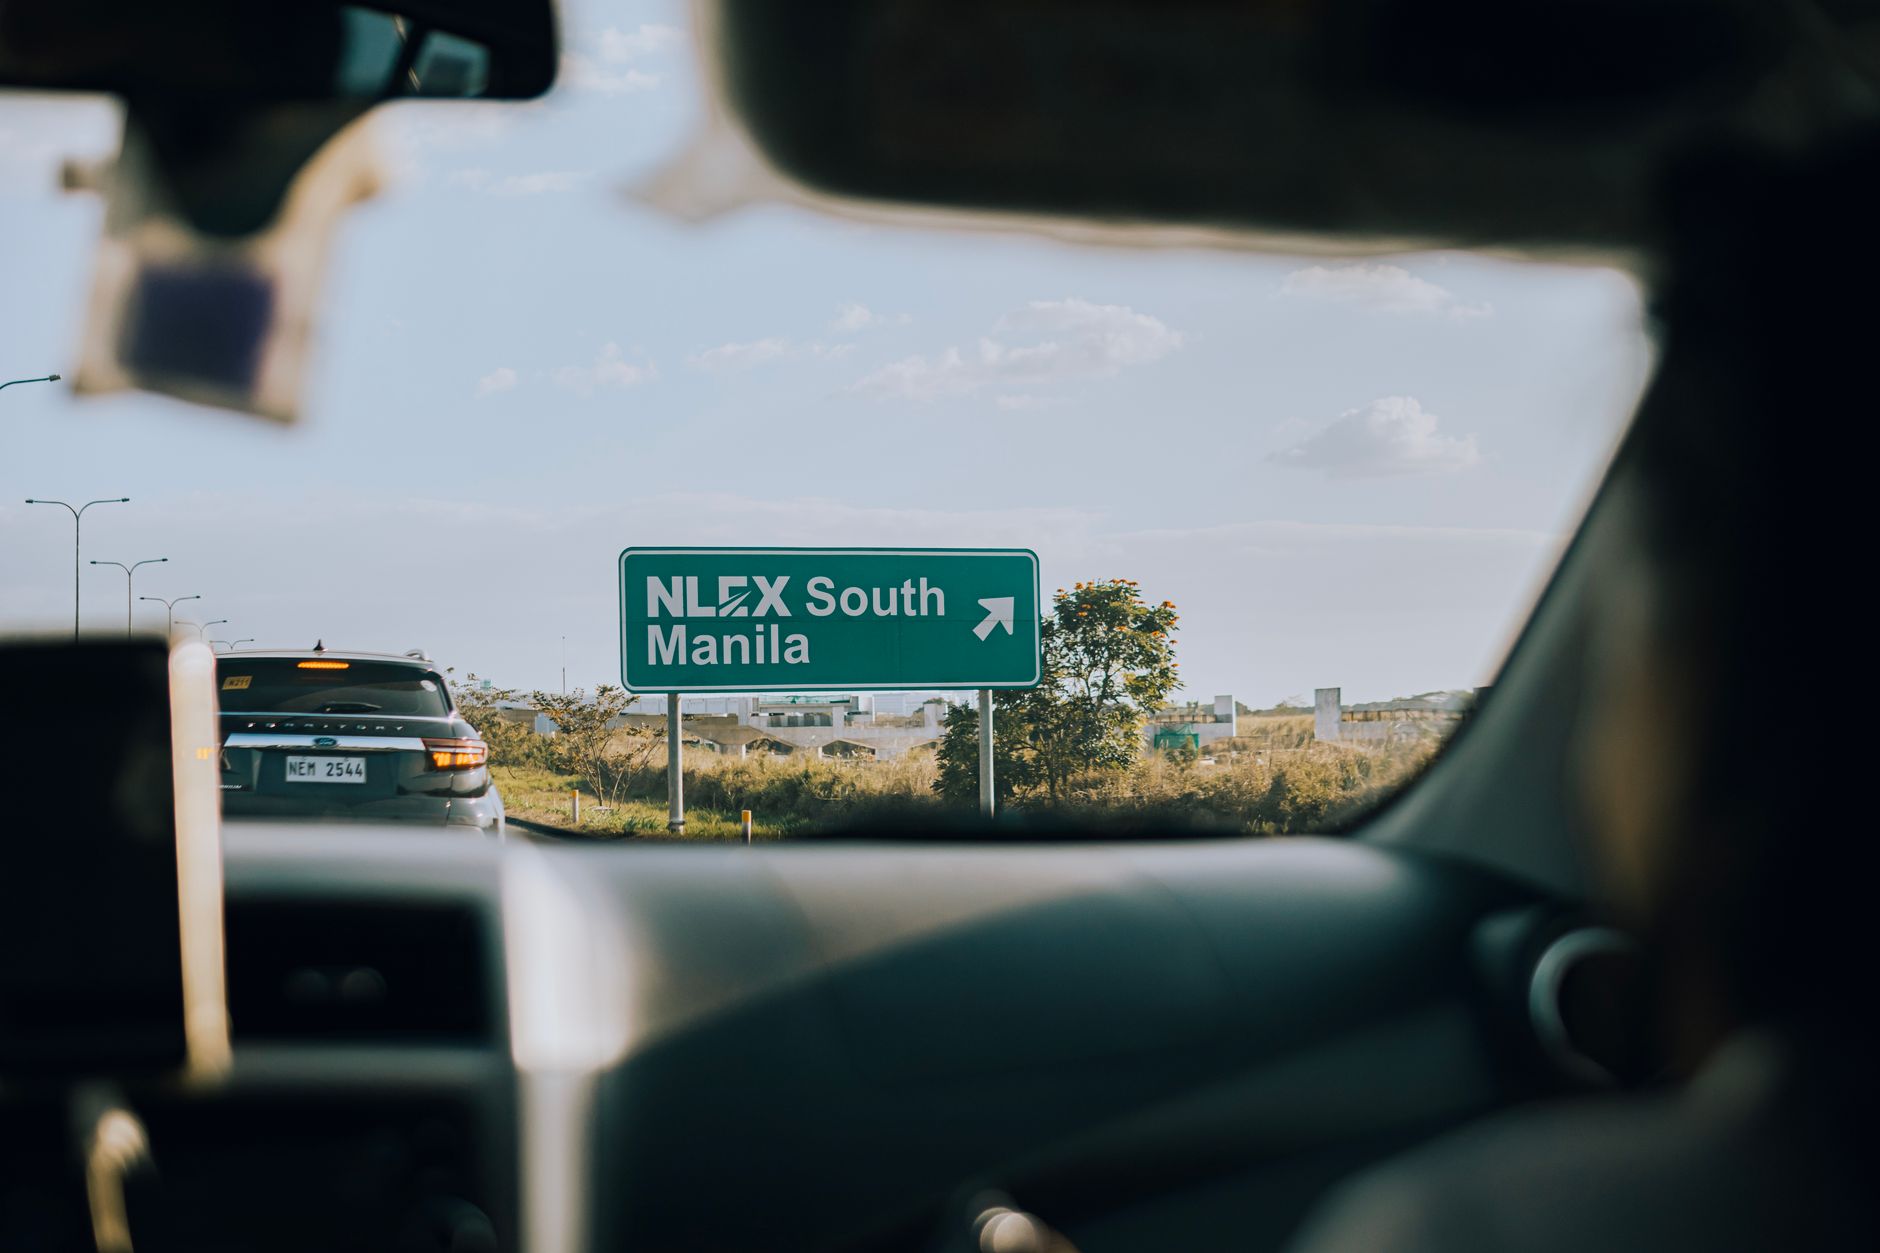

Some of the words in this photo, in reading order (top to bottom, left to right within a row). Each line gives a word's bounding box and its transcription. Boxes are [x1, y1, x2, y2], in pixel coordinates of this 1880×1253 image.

[647, 576, 792, 617] NLEX
[806, 576, 946, 617] South
[647, 624, 810, 665] Manila
[289, 762, 316, 777] NEM
[326, 762, 363, 777] 2544
